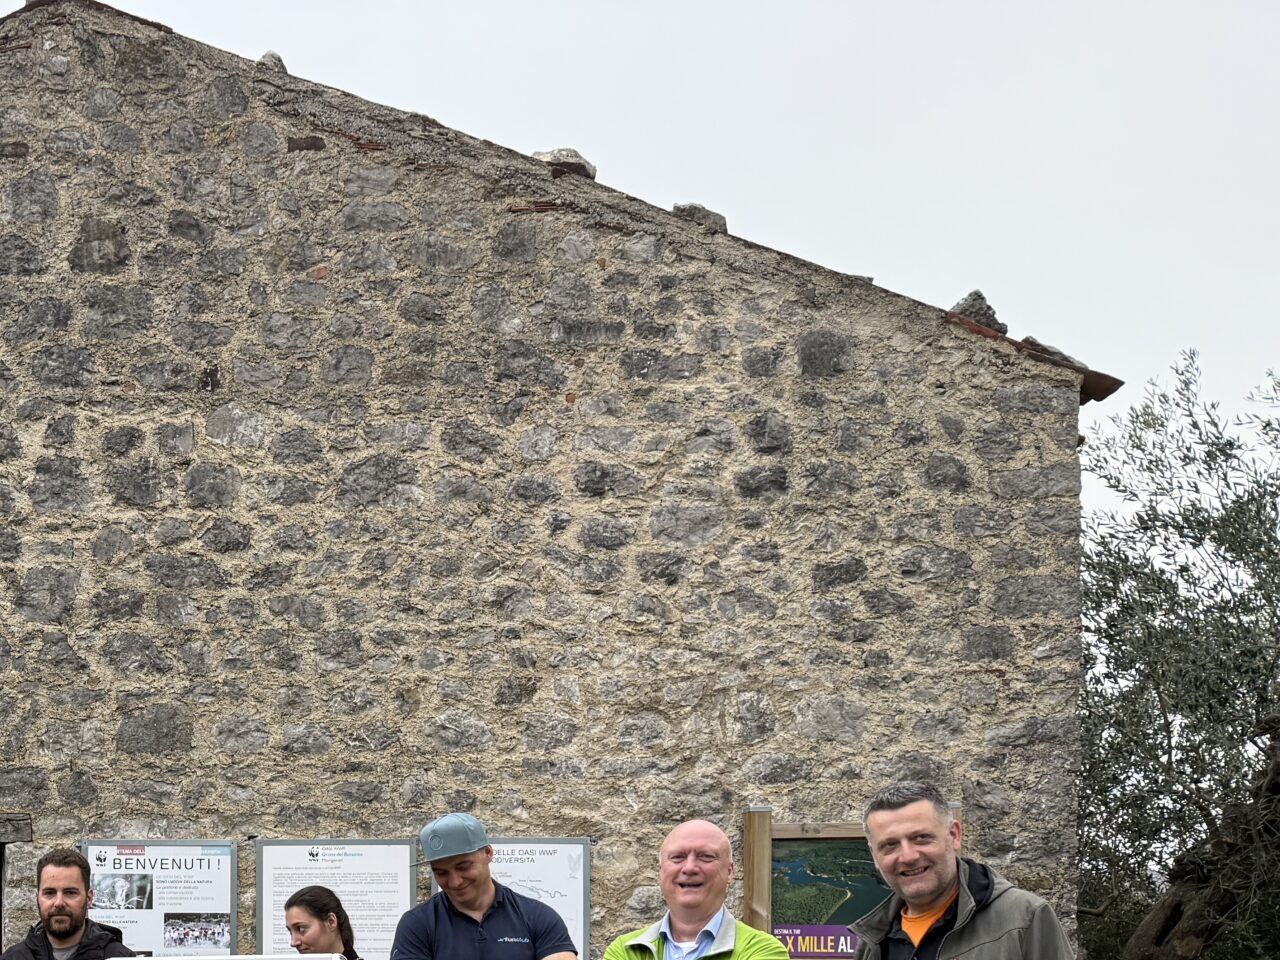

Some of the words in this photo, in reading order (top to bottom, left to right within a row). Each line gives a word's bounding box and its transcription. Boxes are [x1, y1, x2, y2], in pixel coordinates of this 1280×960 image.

[113, 858, 210, 870] BENVENUTI
[787, 936, 794, 952] X
[798, 936, 835, 952] MILLE
[838, 936, 854, 952] AL
